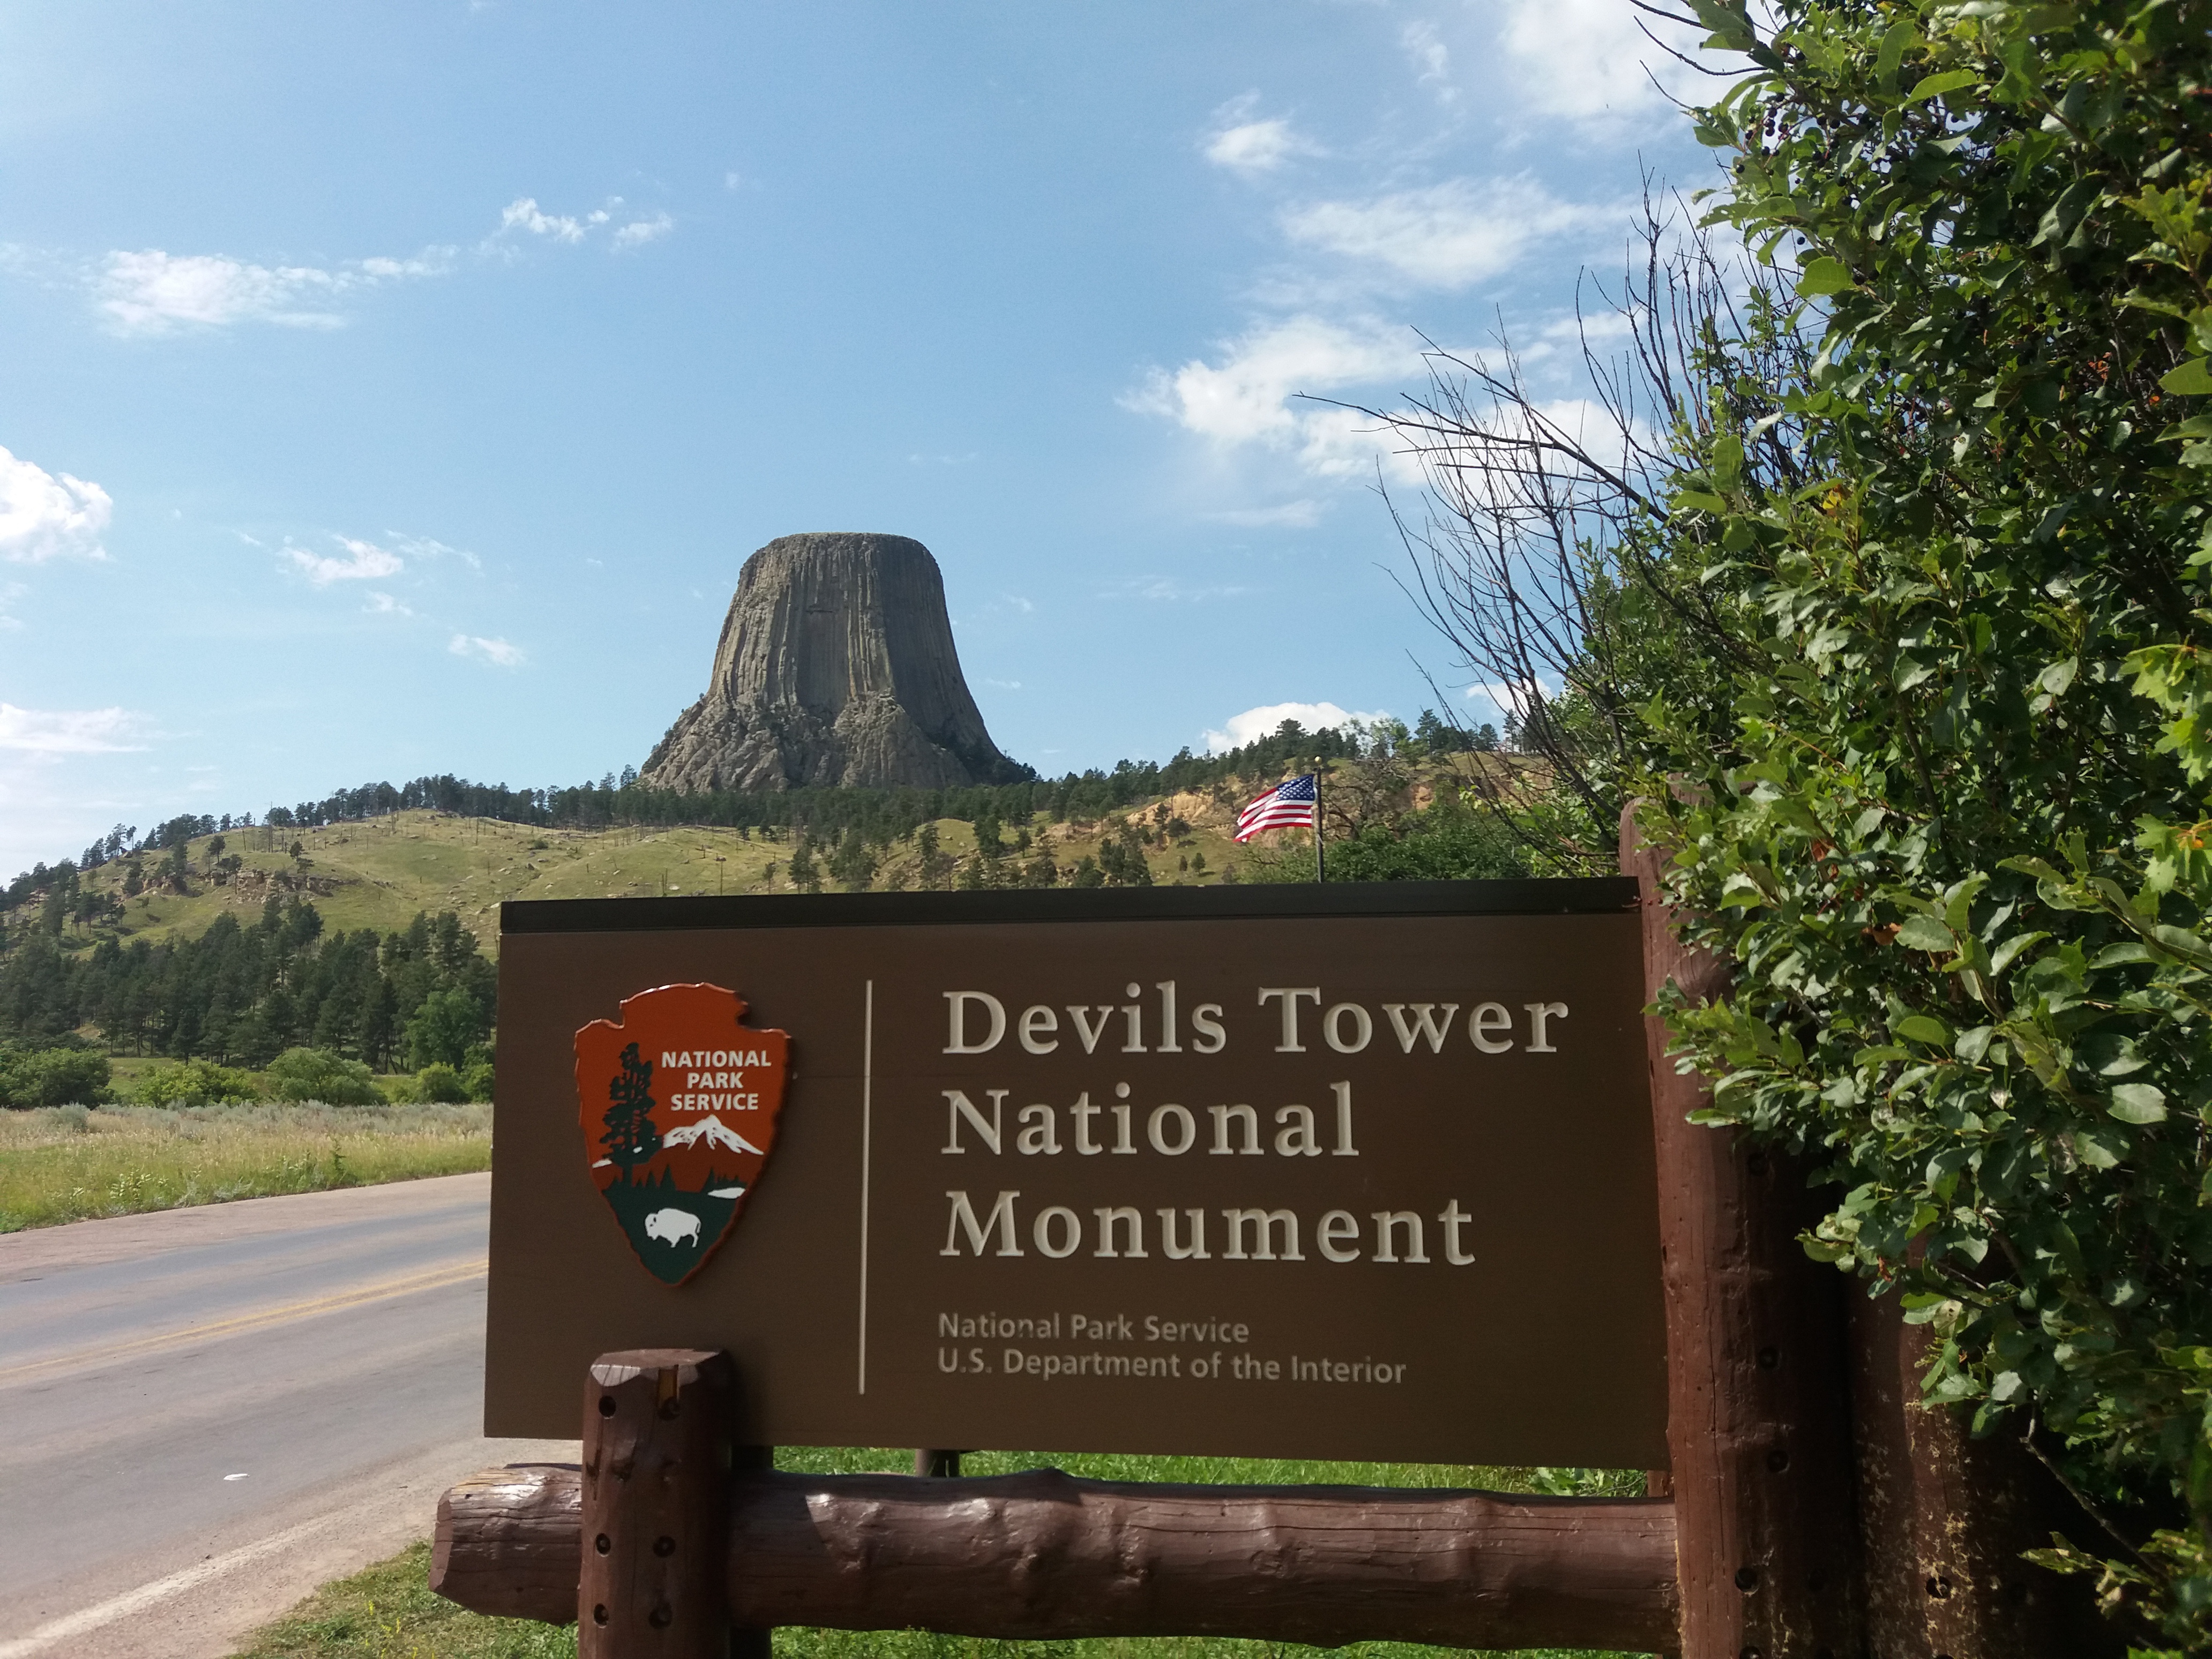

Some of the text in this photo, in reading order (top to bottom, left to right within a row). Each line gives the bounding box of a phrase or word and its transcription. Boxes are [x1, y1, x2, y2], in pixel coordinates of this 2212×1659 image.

[943, 981, 1568, 1054] Devils Tower
[662, 1051, 771, 1067] NATIONAL
[687, 1072, 743, 1088] PARK
[671, 1094, 758, 1110] SERVICE
[942, 1081, 1359, 1156] National
[940, 1191, 1475, 1265] Monument
[939, 1312, 1249, 1343] National Park Service
[939, 1348, 1406, 1383] U.S. Department of the Interior
